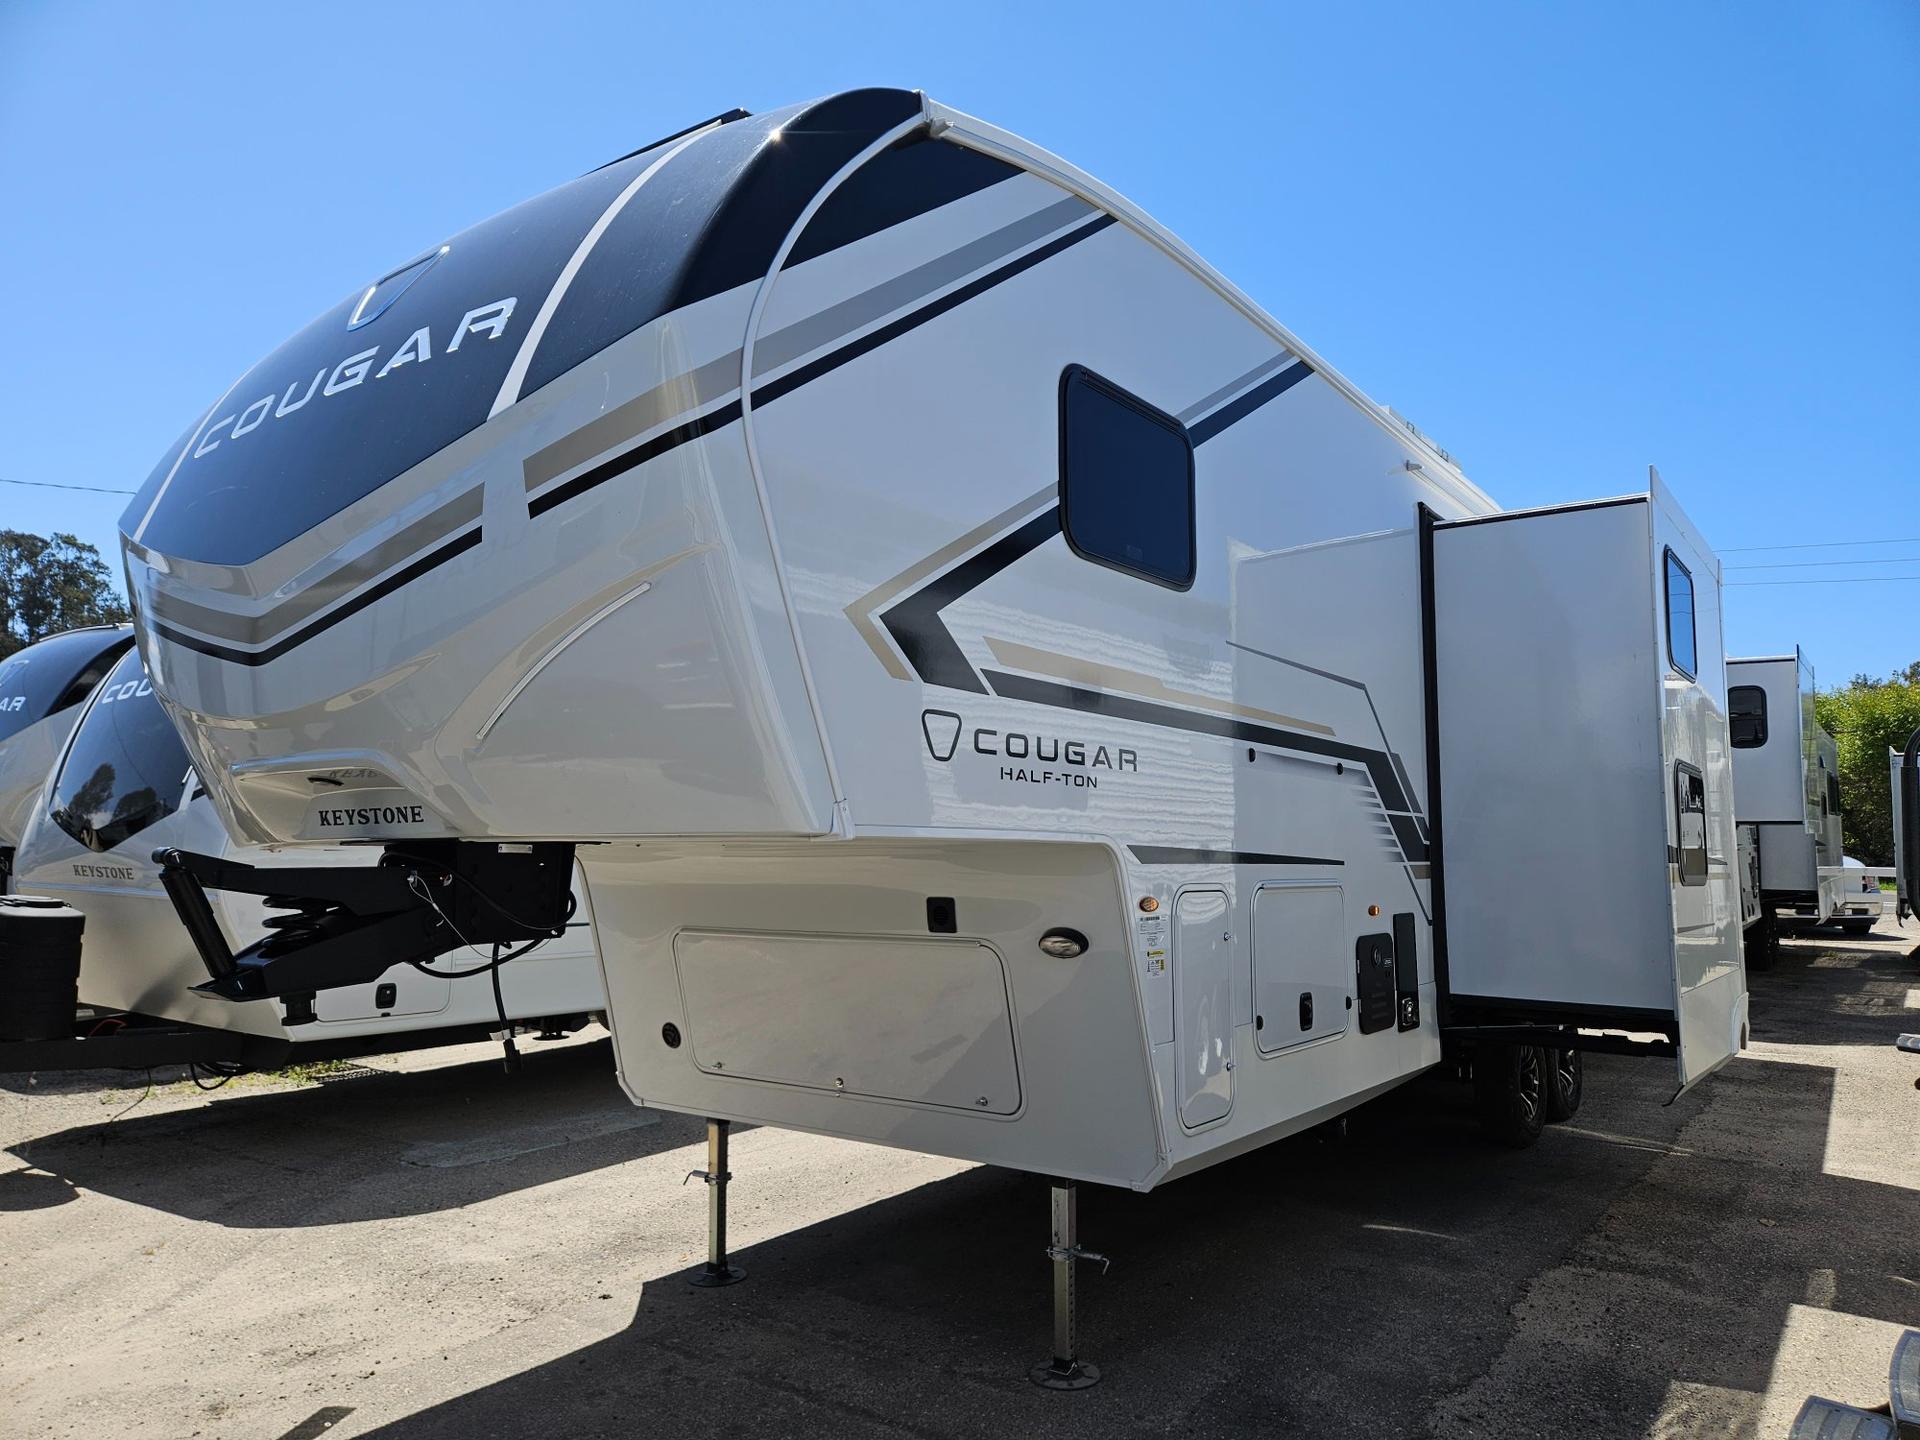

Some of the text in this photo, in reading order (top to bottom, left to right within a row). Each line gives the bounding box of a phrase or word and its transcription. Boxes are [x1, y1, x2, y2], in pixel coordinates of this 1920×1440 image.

[194, 296, 518, 459] COUGAR
[973, 728, 1138, 772] COUGAR
[1000, 766, 1098, 788] HALF-TON
[319, 806, 424, 826] KEYSTONE
[73, 864, 134, 880] KEYSTONE
